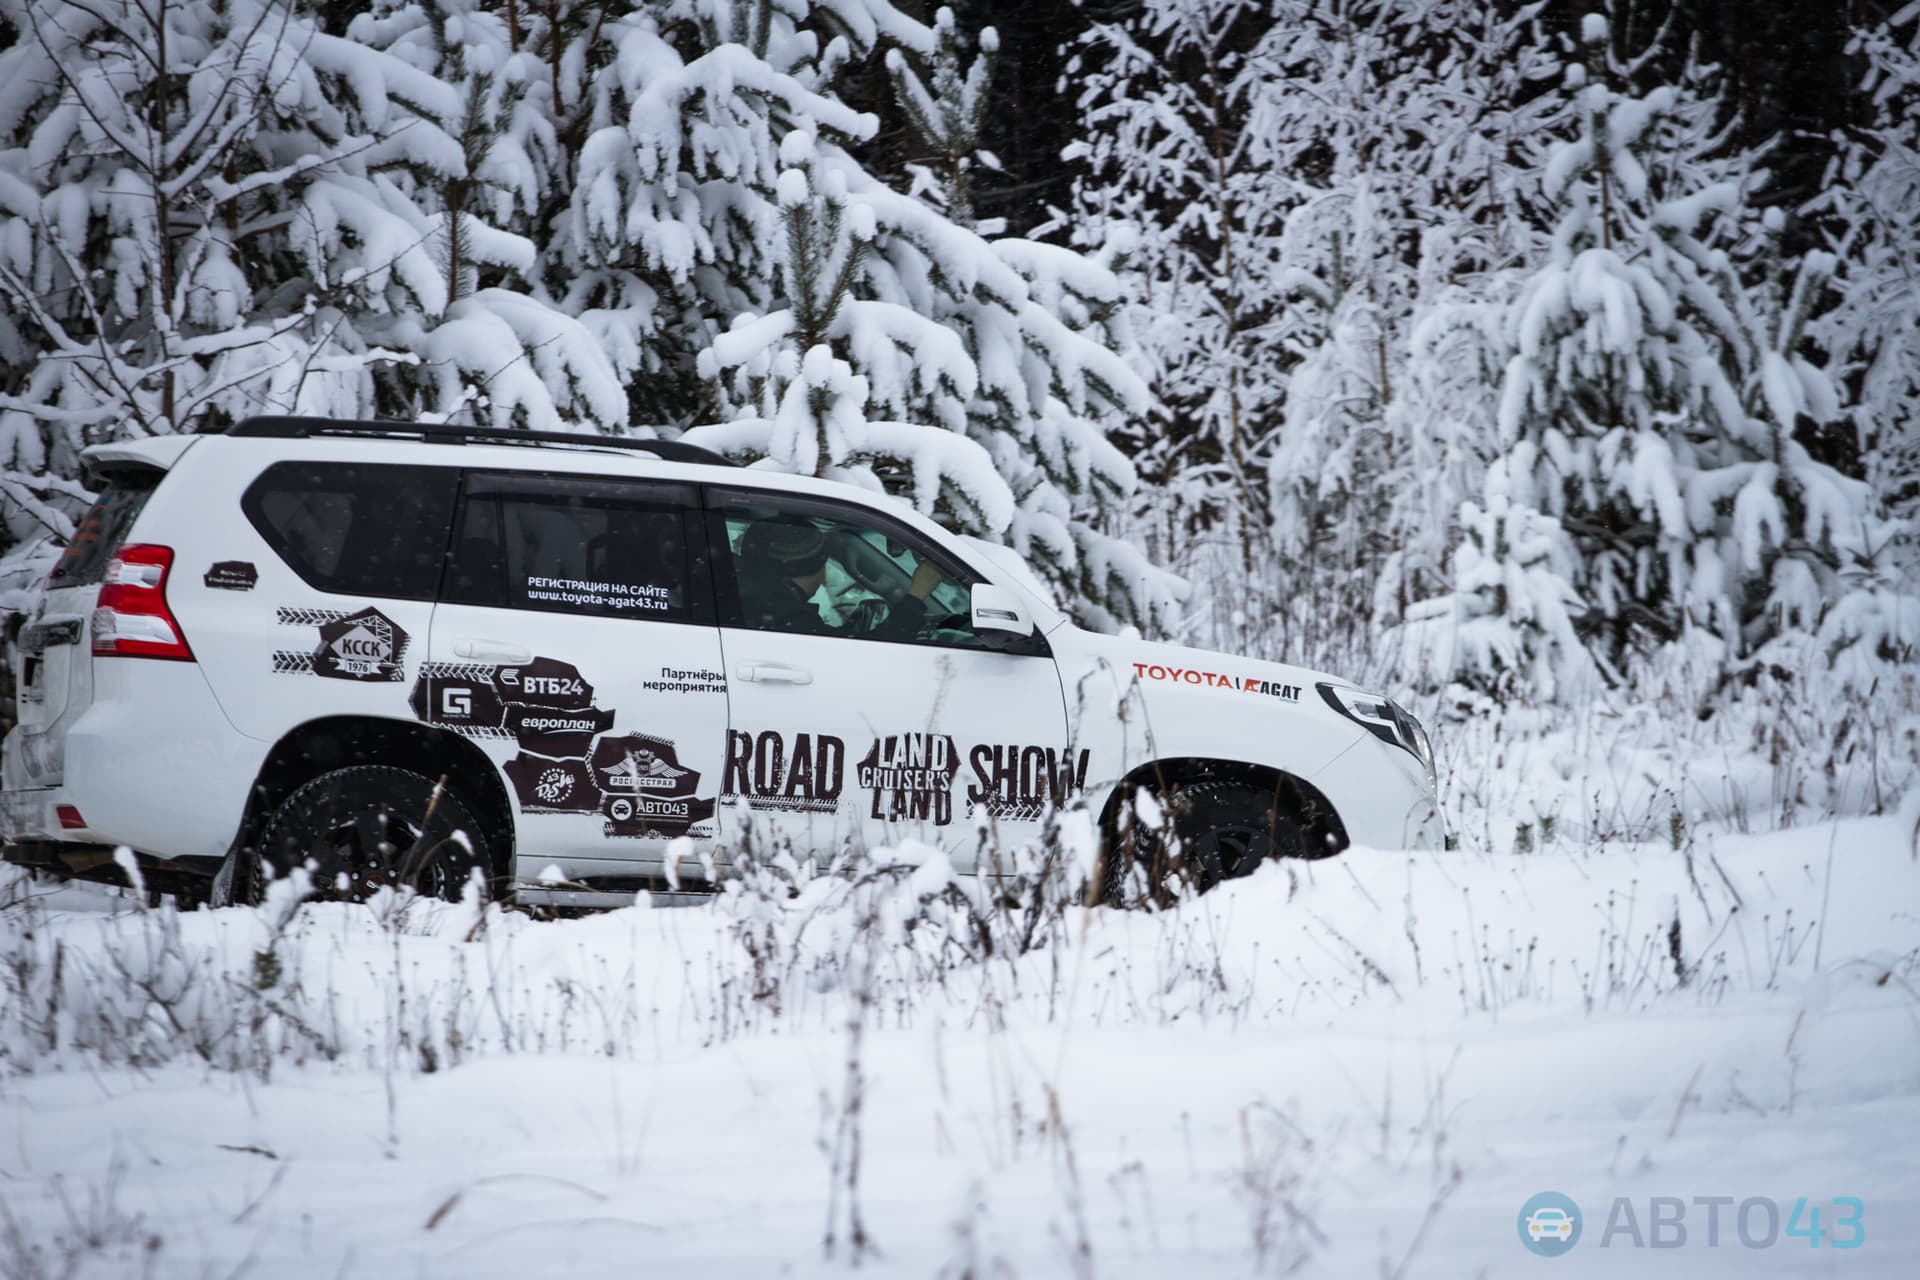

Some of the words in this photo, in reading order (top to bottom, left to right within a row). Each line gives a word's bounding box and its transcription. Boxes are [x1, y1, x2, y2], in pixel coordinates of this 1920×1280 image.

[528, 576, 609, 593] РЕГИСТРАЦИЯ
[611, 584, 628, 594] НА
[630, 584, 669, 598] САЙТЕ
[528, 590, 668, 610] www.toyota-agat43.ru
[348, 662, 368, 672] 1976
[661, 667, 726, 682] Партнёры
[1132, 662, 1234, 690] TOYOTA
[524, 676, 584, 695] ВТБ24
[643, 681, 727, 693] мероприятия
[521, 717, 596, 730] европлан
[878, 732, 949, 771] LAND
[723, 728, 845, 800] ROAD
[613, 777, 673, 786] РОСССТРАХ
[861, 766, 951, 792] CRUISER'S
[967, 744, 1091, 810] SHOW
[636, 801, 689, 815] АВТО43
[871, 787, 952, 826] LAND
